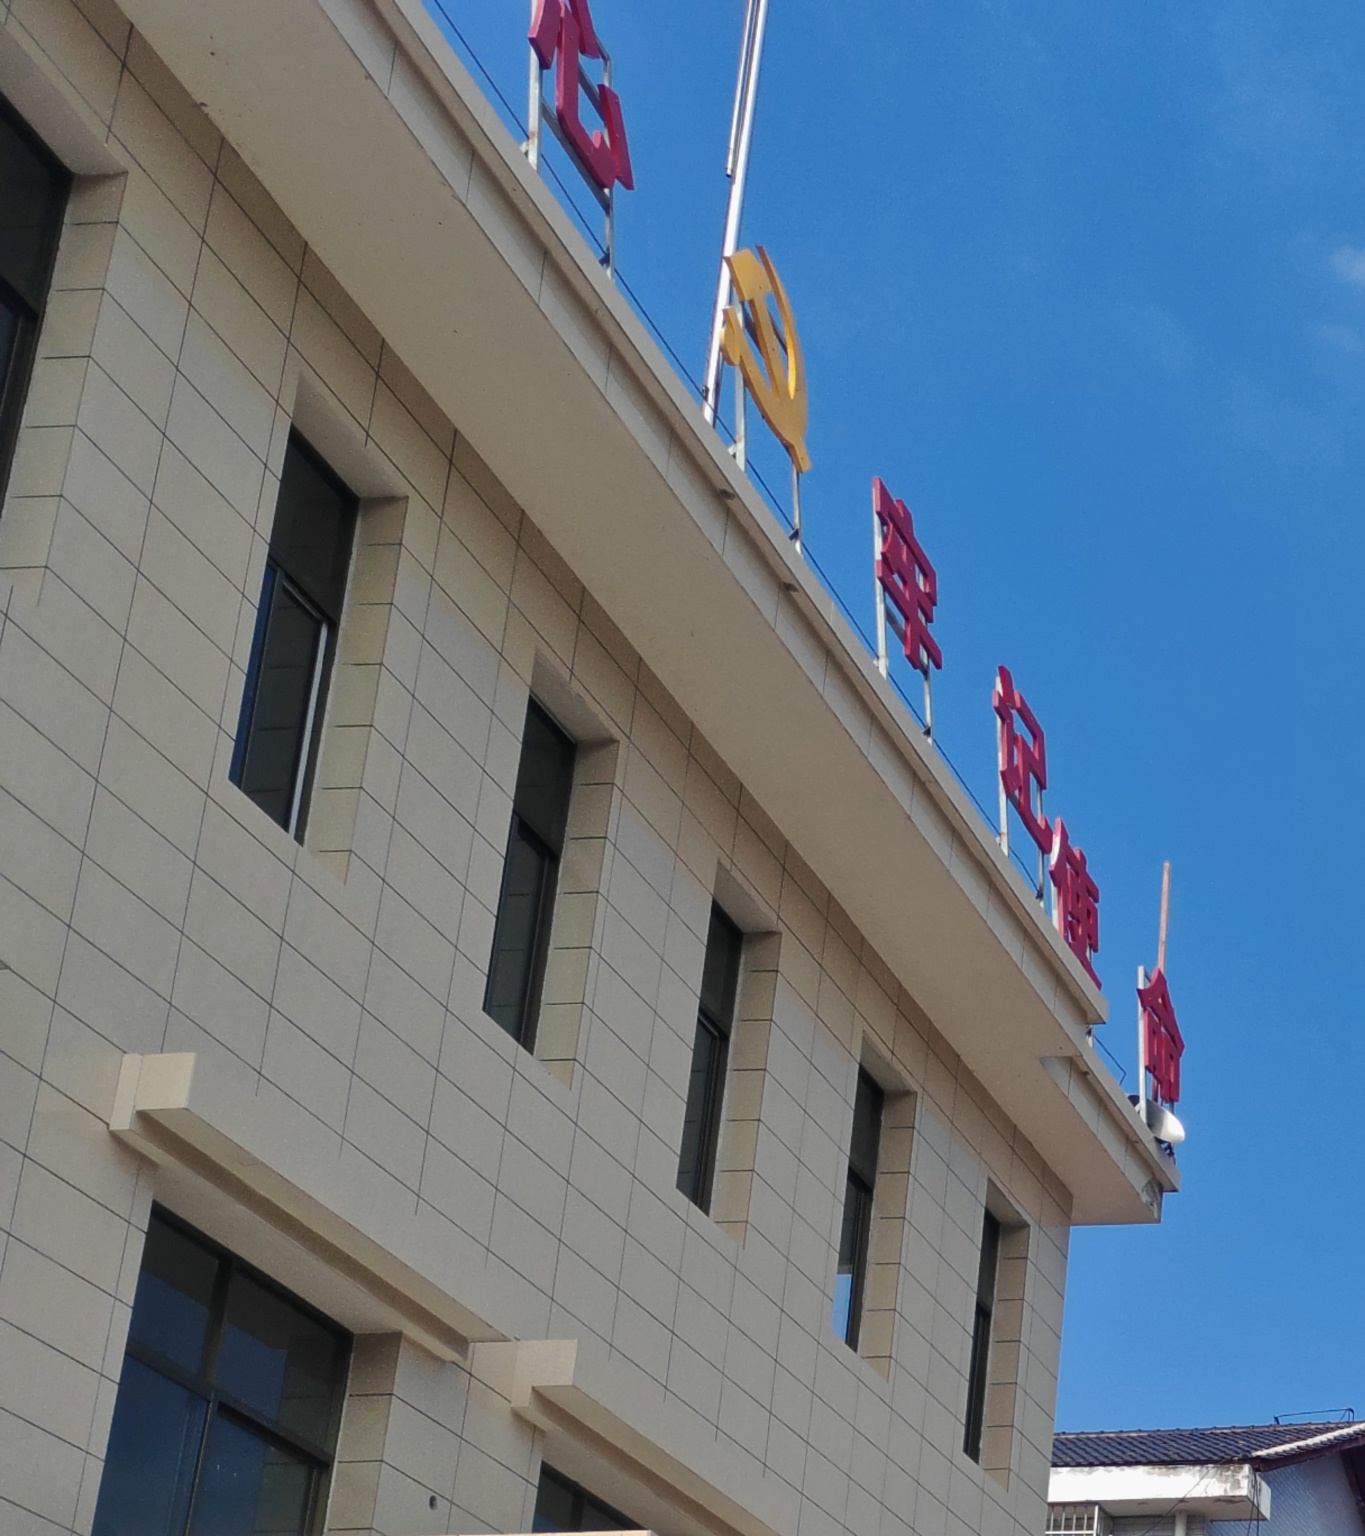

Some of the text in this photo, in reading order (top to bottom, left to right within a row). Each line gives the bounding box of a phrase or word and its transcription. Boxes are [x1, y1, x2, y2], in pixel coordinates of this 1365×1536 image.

[528, 0, 1184, 1104] 心 牢记使命
